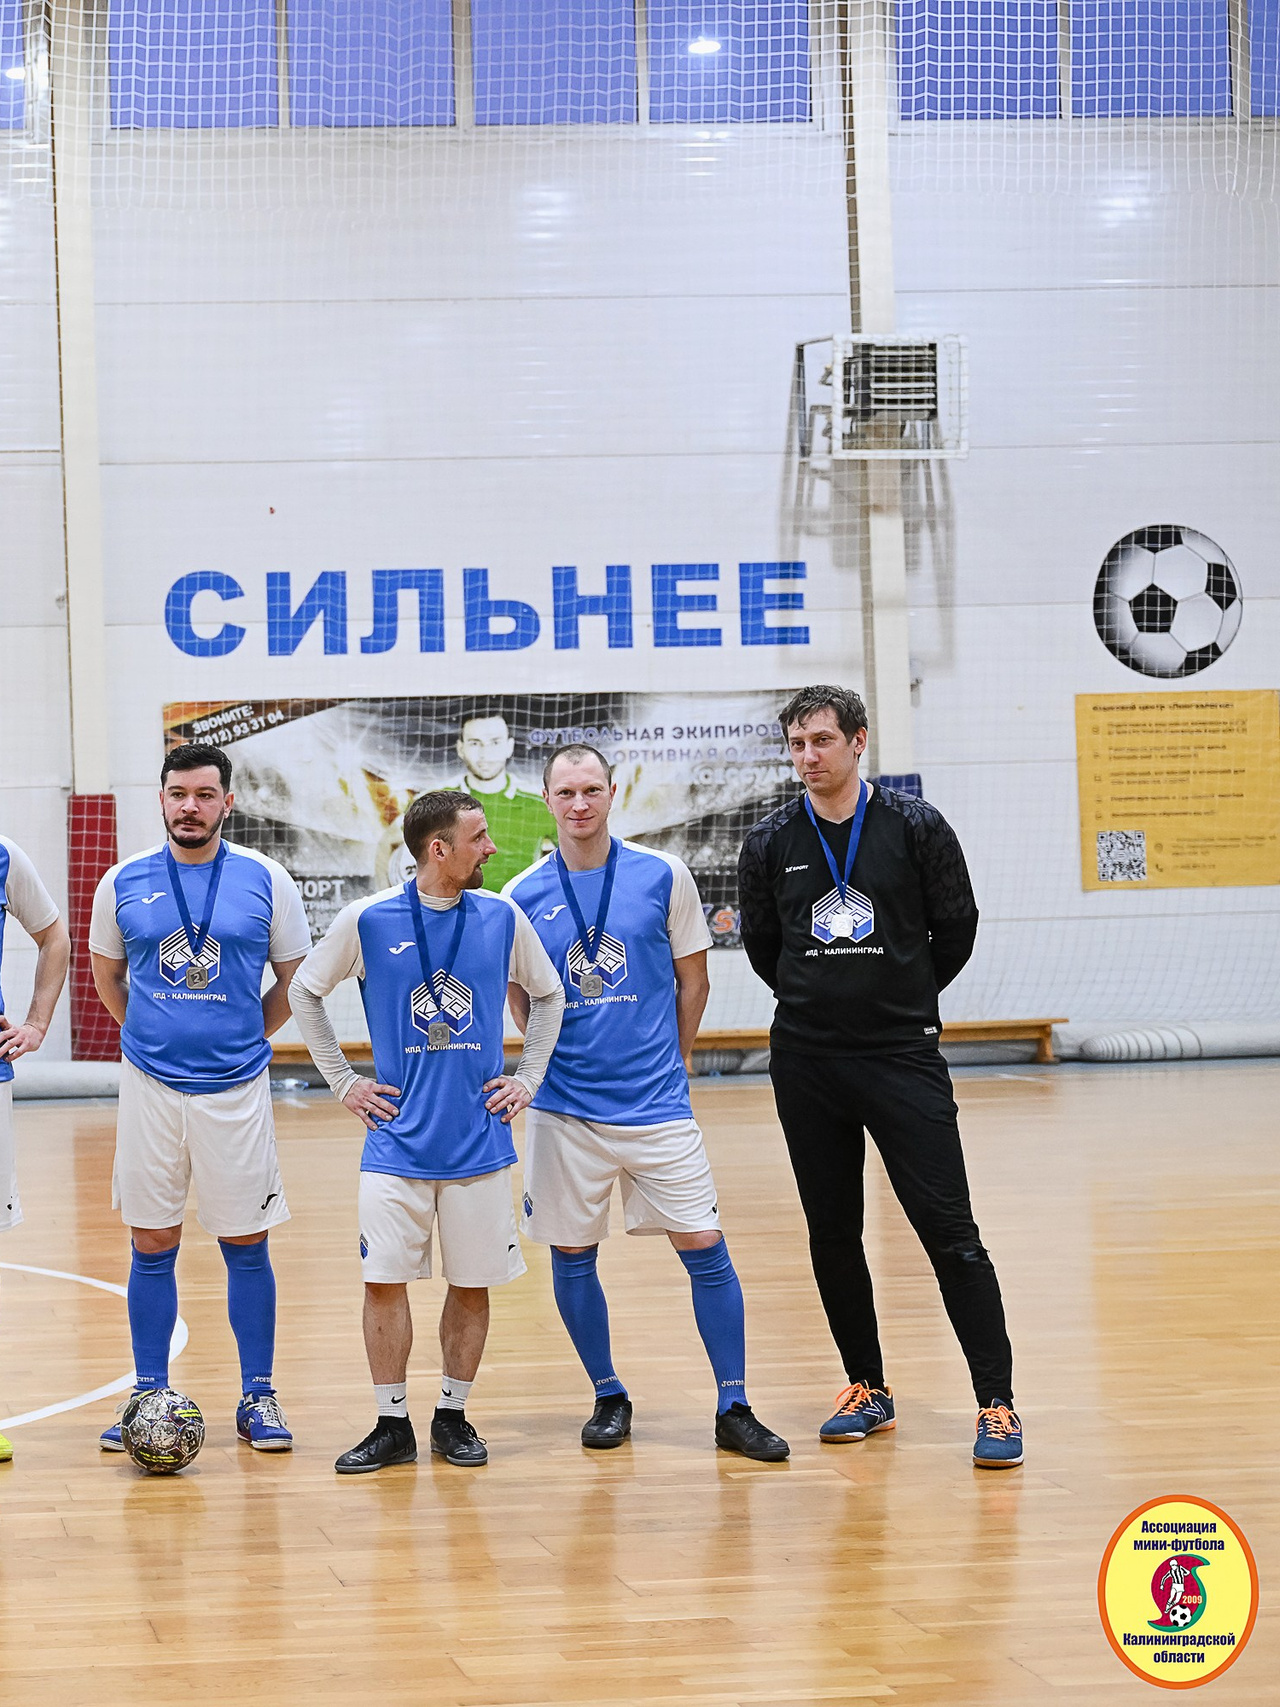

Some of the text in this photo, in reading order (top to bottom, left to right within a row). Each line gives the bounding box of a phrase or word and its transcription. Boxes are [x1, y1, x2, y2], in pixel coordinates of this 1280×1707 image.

[164, 561, 810, 658] СИЛЬНЕЕ
[192, 705, 255, 735] ЗВОНИТЕ:
[233, 723, 250, 738] 93
[249, 716, 266, 731] 31
[267, 709, 285, 725] 04
[530, 726, 665, 745] ФУТБОЛЬНАЯ
[606, 747, 718, 763] ОРТИВНАЯ
[824, 947, 884, 956] КАЛИНИНГРАД
[152, 992, 167, 1000] КПД
[172, 992, 227, 1002] КАЛИНИНГРАД
[585, 994, 638, 1006] КАЛИНИНГРАД
[405, 1045, 422, 1054] КПД
[427, 1042, 481, 1052] КАЛИНИНГРАД
